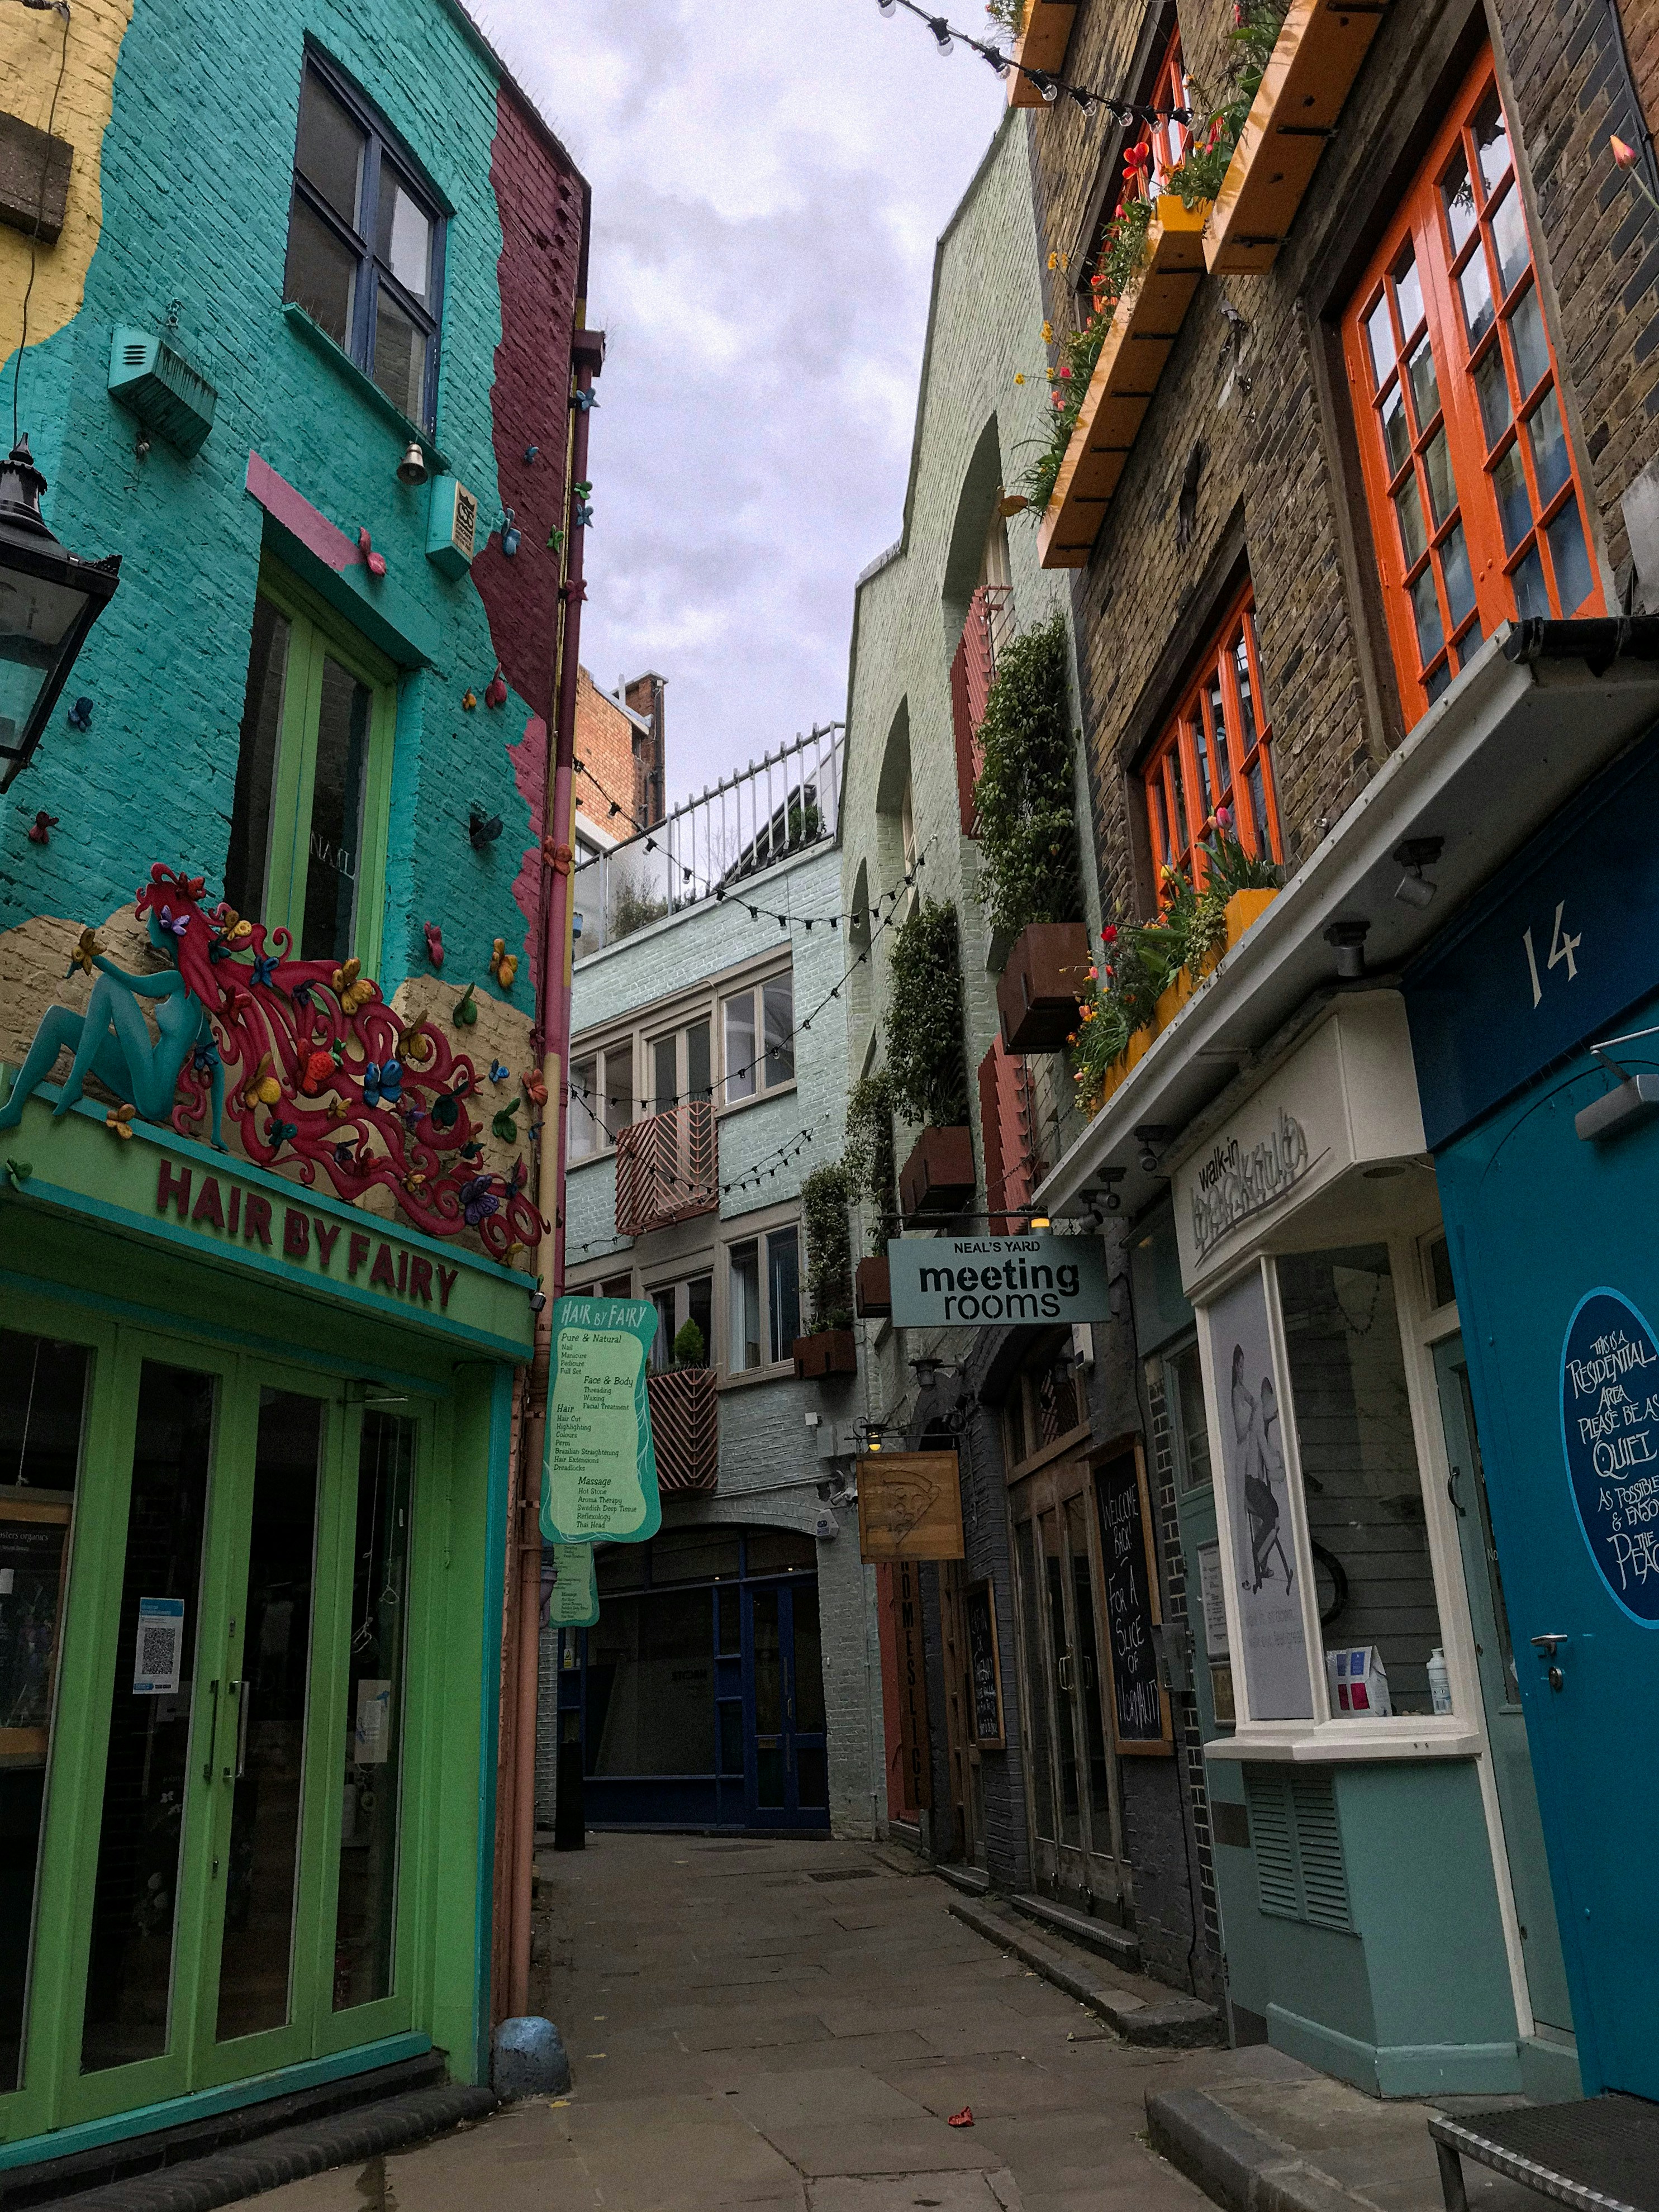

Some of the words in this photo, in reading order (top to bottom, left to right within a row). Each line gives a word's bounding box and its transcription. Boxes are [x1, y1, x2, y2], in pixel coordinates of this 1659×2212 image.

[1523, 900, 1582, 1009] 14
[1199, 1136, 1239, 1192] walk-in
[156, 1158, 273, 1245] HAIR
[283, 1207, 342, 1266] BY
[348, 1231, 459, 1307] FAIRY
[1004, 1241, 1040, 1252] YARD
[919, 1257, 1080, 1297] meeting
[560, 1300, 591, 1326] HAIR
[594, 1311, 607, 1326] BY
[607, 1305, 647, 1328] FAIRY
[944, 1292, 1061, 1320] rooms
[560, 1333, 579, 1342] Pure
[593, 1334, 622, 1343] Natural
[1590, 1335, 1610, 1355] THIS
[1609, 1330, 1618, 1351] IS
[1617, 1329, 1629, 1345] A
[583, 1376, 601, 1384] Face
[603, 1376, 611, 1384] &
[614, 1377, 633, 1388] Body
[1565, 1339, 1658, 1400] RESIDENTIAL
[584, 1386, 612, 1395] Threading
[1595, 1384, 1633, 1415] AREA
[557, 1404, 574, 1413] Hair
[556, 1424, 591, 1432] Highlighting
[1577, 1410, 1620, 1445] PLEASE
[1622, 1401, 1643, 1426] BE
[581, 1448, 619, 1457] Straightening
[1593, 1430, 1658, 1480] QUIET
[578, 1476, 611, 1488] Massage
[1597, 1487, 1613, 1512] AS
[1614, 1474, 1659, 1509] POSSIBLE
[599, 1496, 622, 1505] Therapy
[1100, 1481, 1139, 1531] WELCOME
[1612, 1512, 1623, 1531] &
[1624, 1497, 1659, 1526] ENJO
[577, 1512, 611, 1522] Reflexology
[20, 1533, 49, 1542] organics
[1633, 1530, 1657, 1551] THE
[1109, 1572, 1128, 1616] FOR
[1130, 1564, 1139, 1607] A
[1115, 1614, 1145, 1657] SLICE
[1127, 1650, 1139, 1674] OF
[1118, 1675, 1161, 1730] NORMALITY
